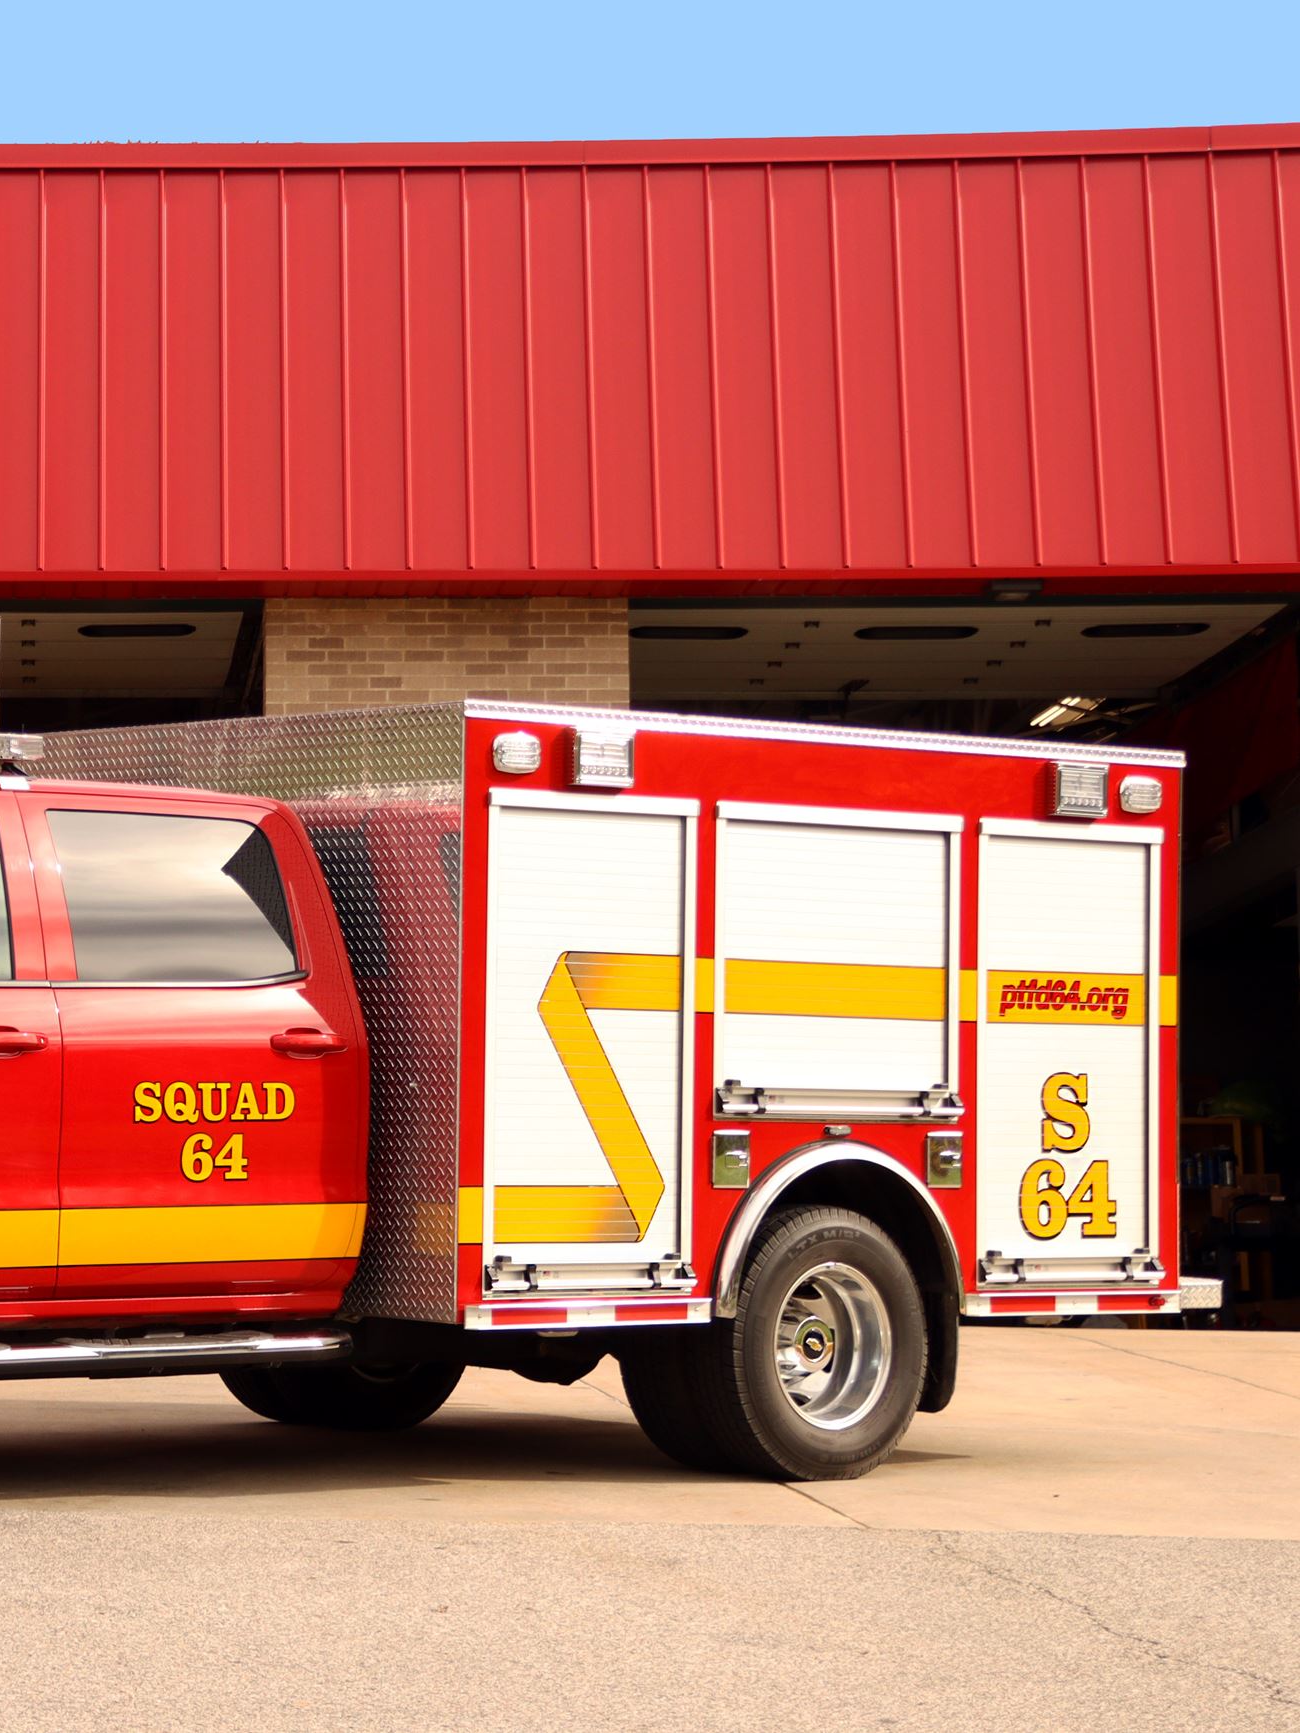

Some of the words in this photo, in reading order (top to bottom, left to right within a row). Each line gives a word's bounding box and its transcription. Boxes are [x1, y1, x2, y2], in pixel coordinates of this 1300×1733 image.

[999, 979, 1129, 1020] ptfd64.org
[133, 1081, 295, 1124] SQUAD
[1041, 1072, 1090, 1153] S
[181, 1133, 248, 1182] 64
[1019, 1158, 1117, 1240] 64
